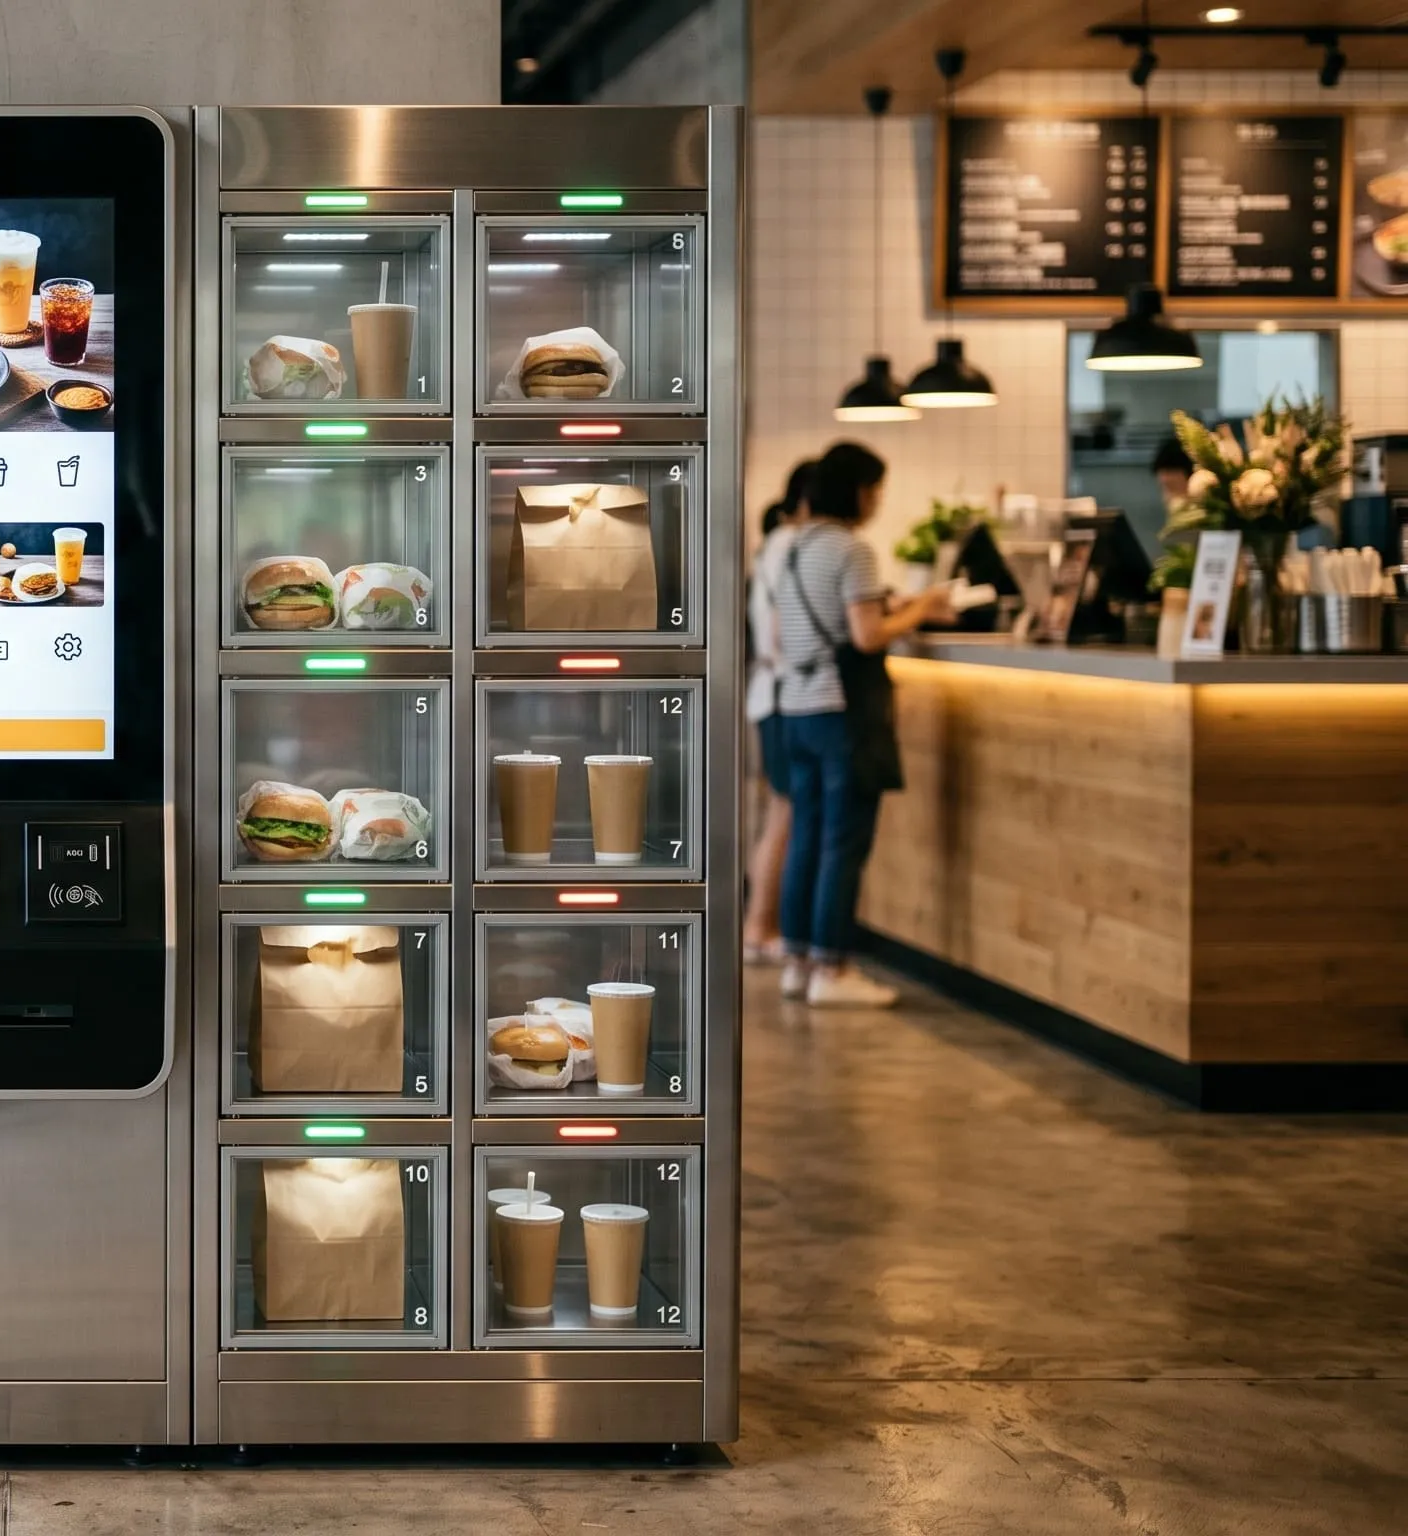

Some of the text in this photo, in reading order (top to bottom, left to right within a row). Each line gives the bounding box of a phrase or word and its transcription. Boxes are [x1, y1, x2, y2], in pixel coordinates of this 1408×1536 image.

[417, 375, 426, 393] 1
[671, 377, 684, 393] 2
[414, 465, 427, 482] 3
[415, 607, 427, 625] 6
[670, 607, 683, 625] 5
[415, 697, 427, 714] 5
[659, 697, 683, 714] 12
[415, 839, 428, 859] 6
[669, 840, 682, 859] 7
[413, 932, 427, 949] 7
[658, 932, 679, 949] 11
[415, 1075, 428, 1093] 5
[669, 1075, 682, 1093] 8
[405, 1165, 429, 1182] 10
[657, 1163, 680, 1181] 12
[414, 1306, 428, 1325] 8
[657, 1305, 681, 1323] 12
